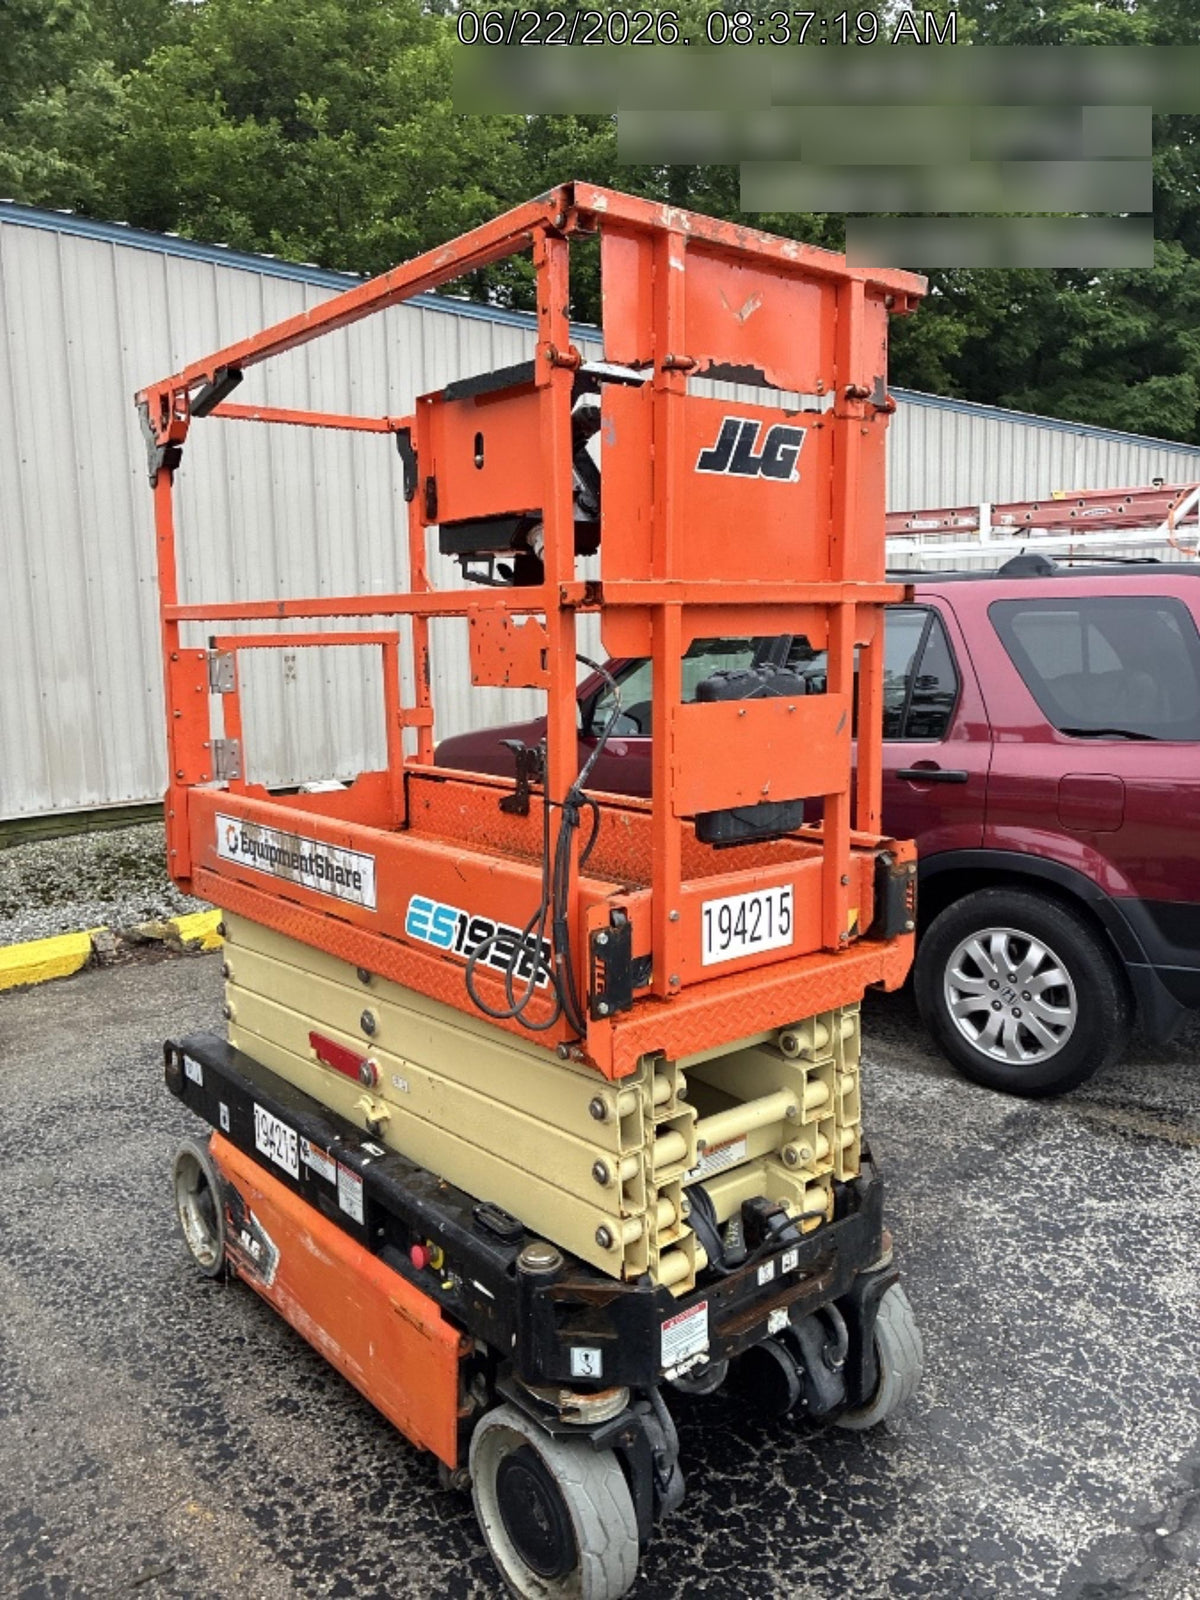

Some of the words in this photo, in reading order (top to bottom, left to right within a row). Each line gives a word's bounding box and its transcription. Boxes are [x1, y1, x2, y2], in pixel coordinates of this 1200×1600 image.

[696, 416, 806, 482] JLG
[240, 831, 362, 891] EquipmentShare
[704, 892, 790, 953] 194215
[254, 1108, 299, 1169] 194215
